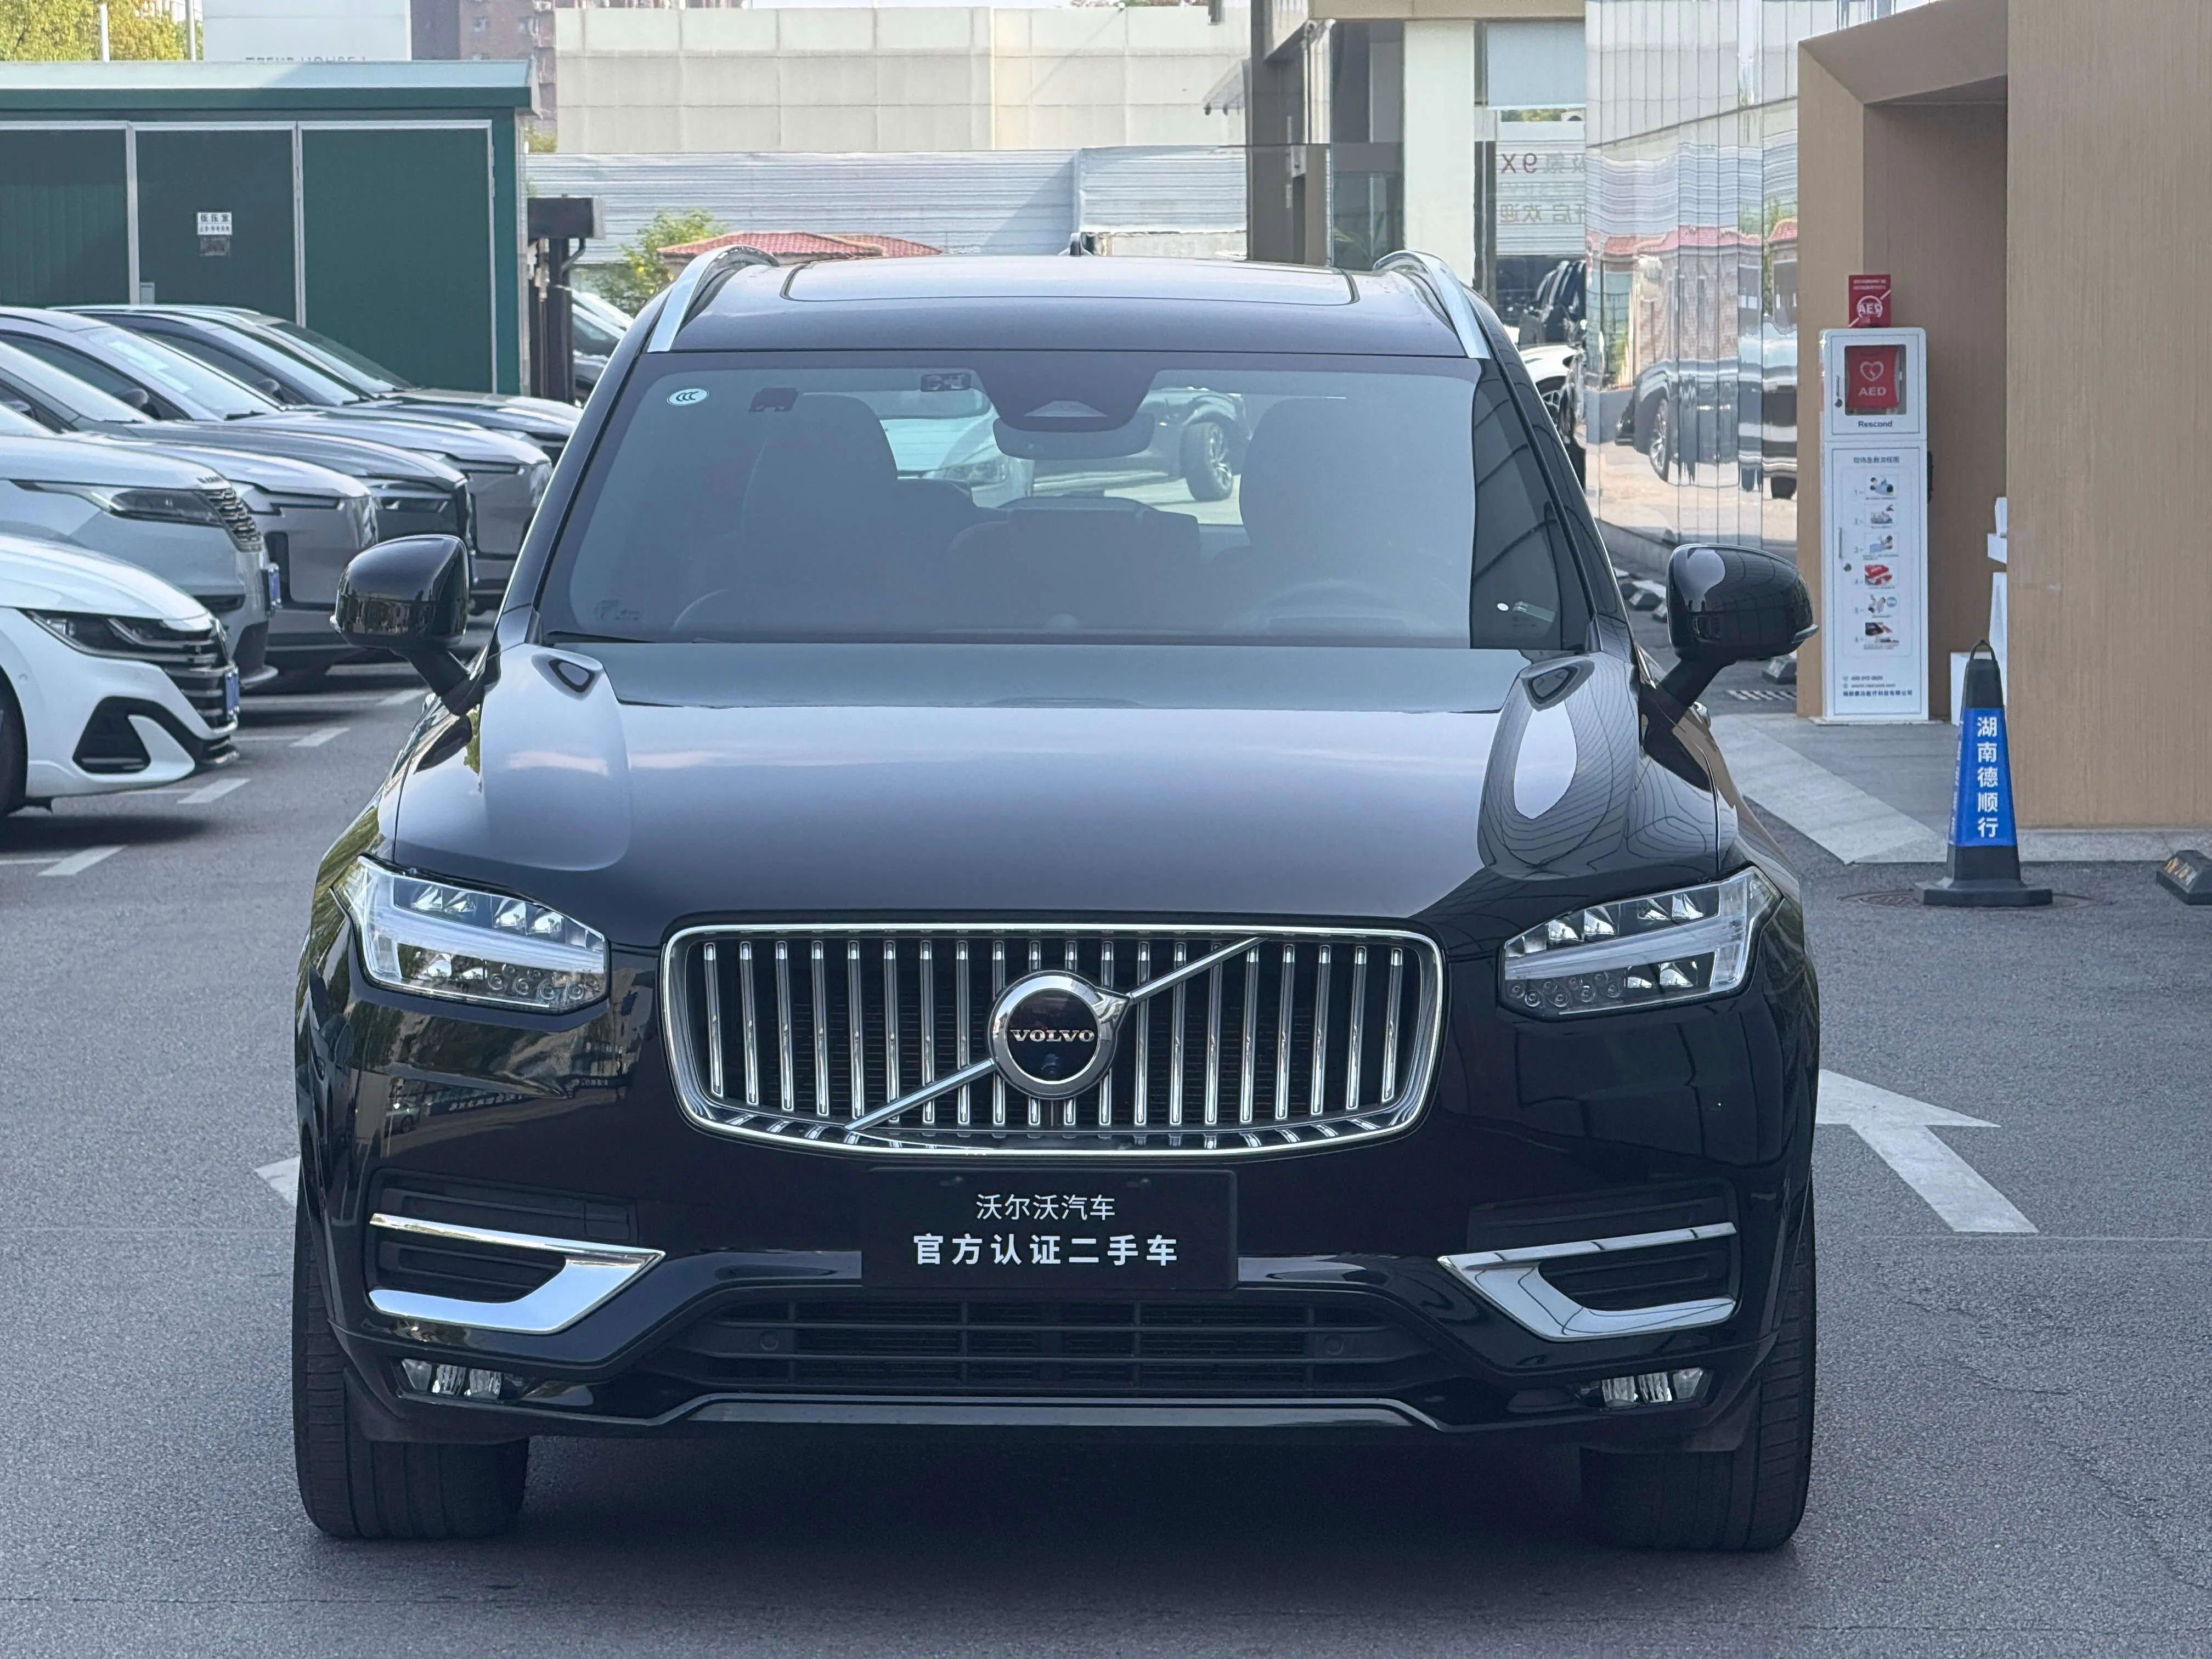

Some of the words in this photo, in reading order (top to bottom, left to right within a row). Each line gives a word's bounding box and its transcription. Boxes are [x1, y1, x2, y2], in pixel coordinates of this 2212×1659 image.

[1858, 386, 1887, 397] AED
[1977, 715, 1999, 838] 湖南德顺行
[1009, 1029, 1096, 1042] VOLVO
[975, 1193, 1116, 1221] 沃尔沃汽车
[913, 1233, 1178, 1267] 官方认证二手车
